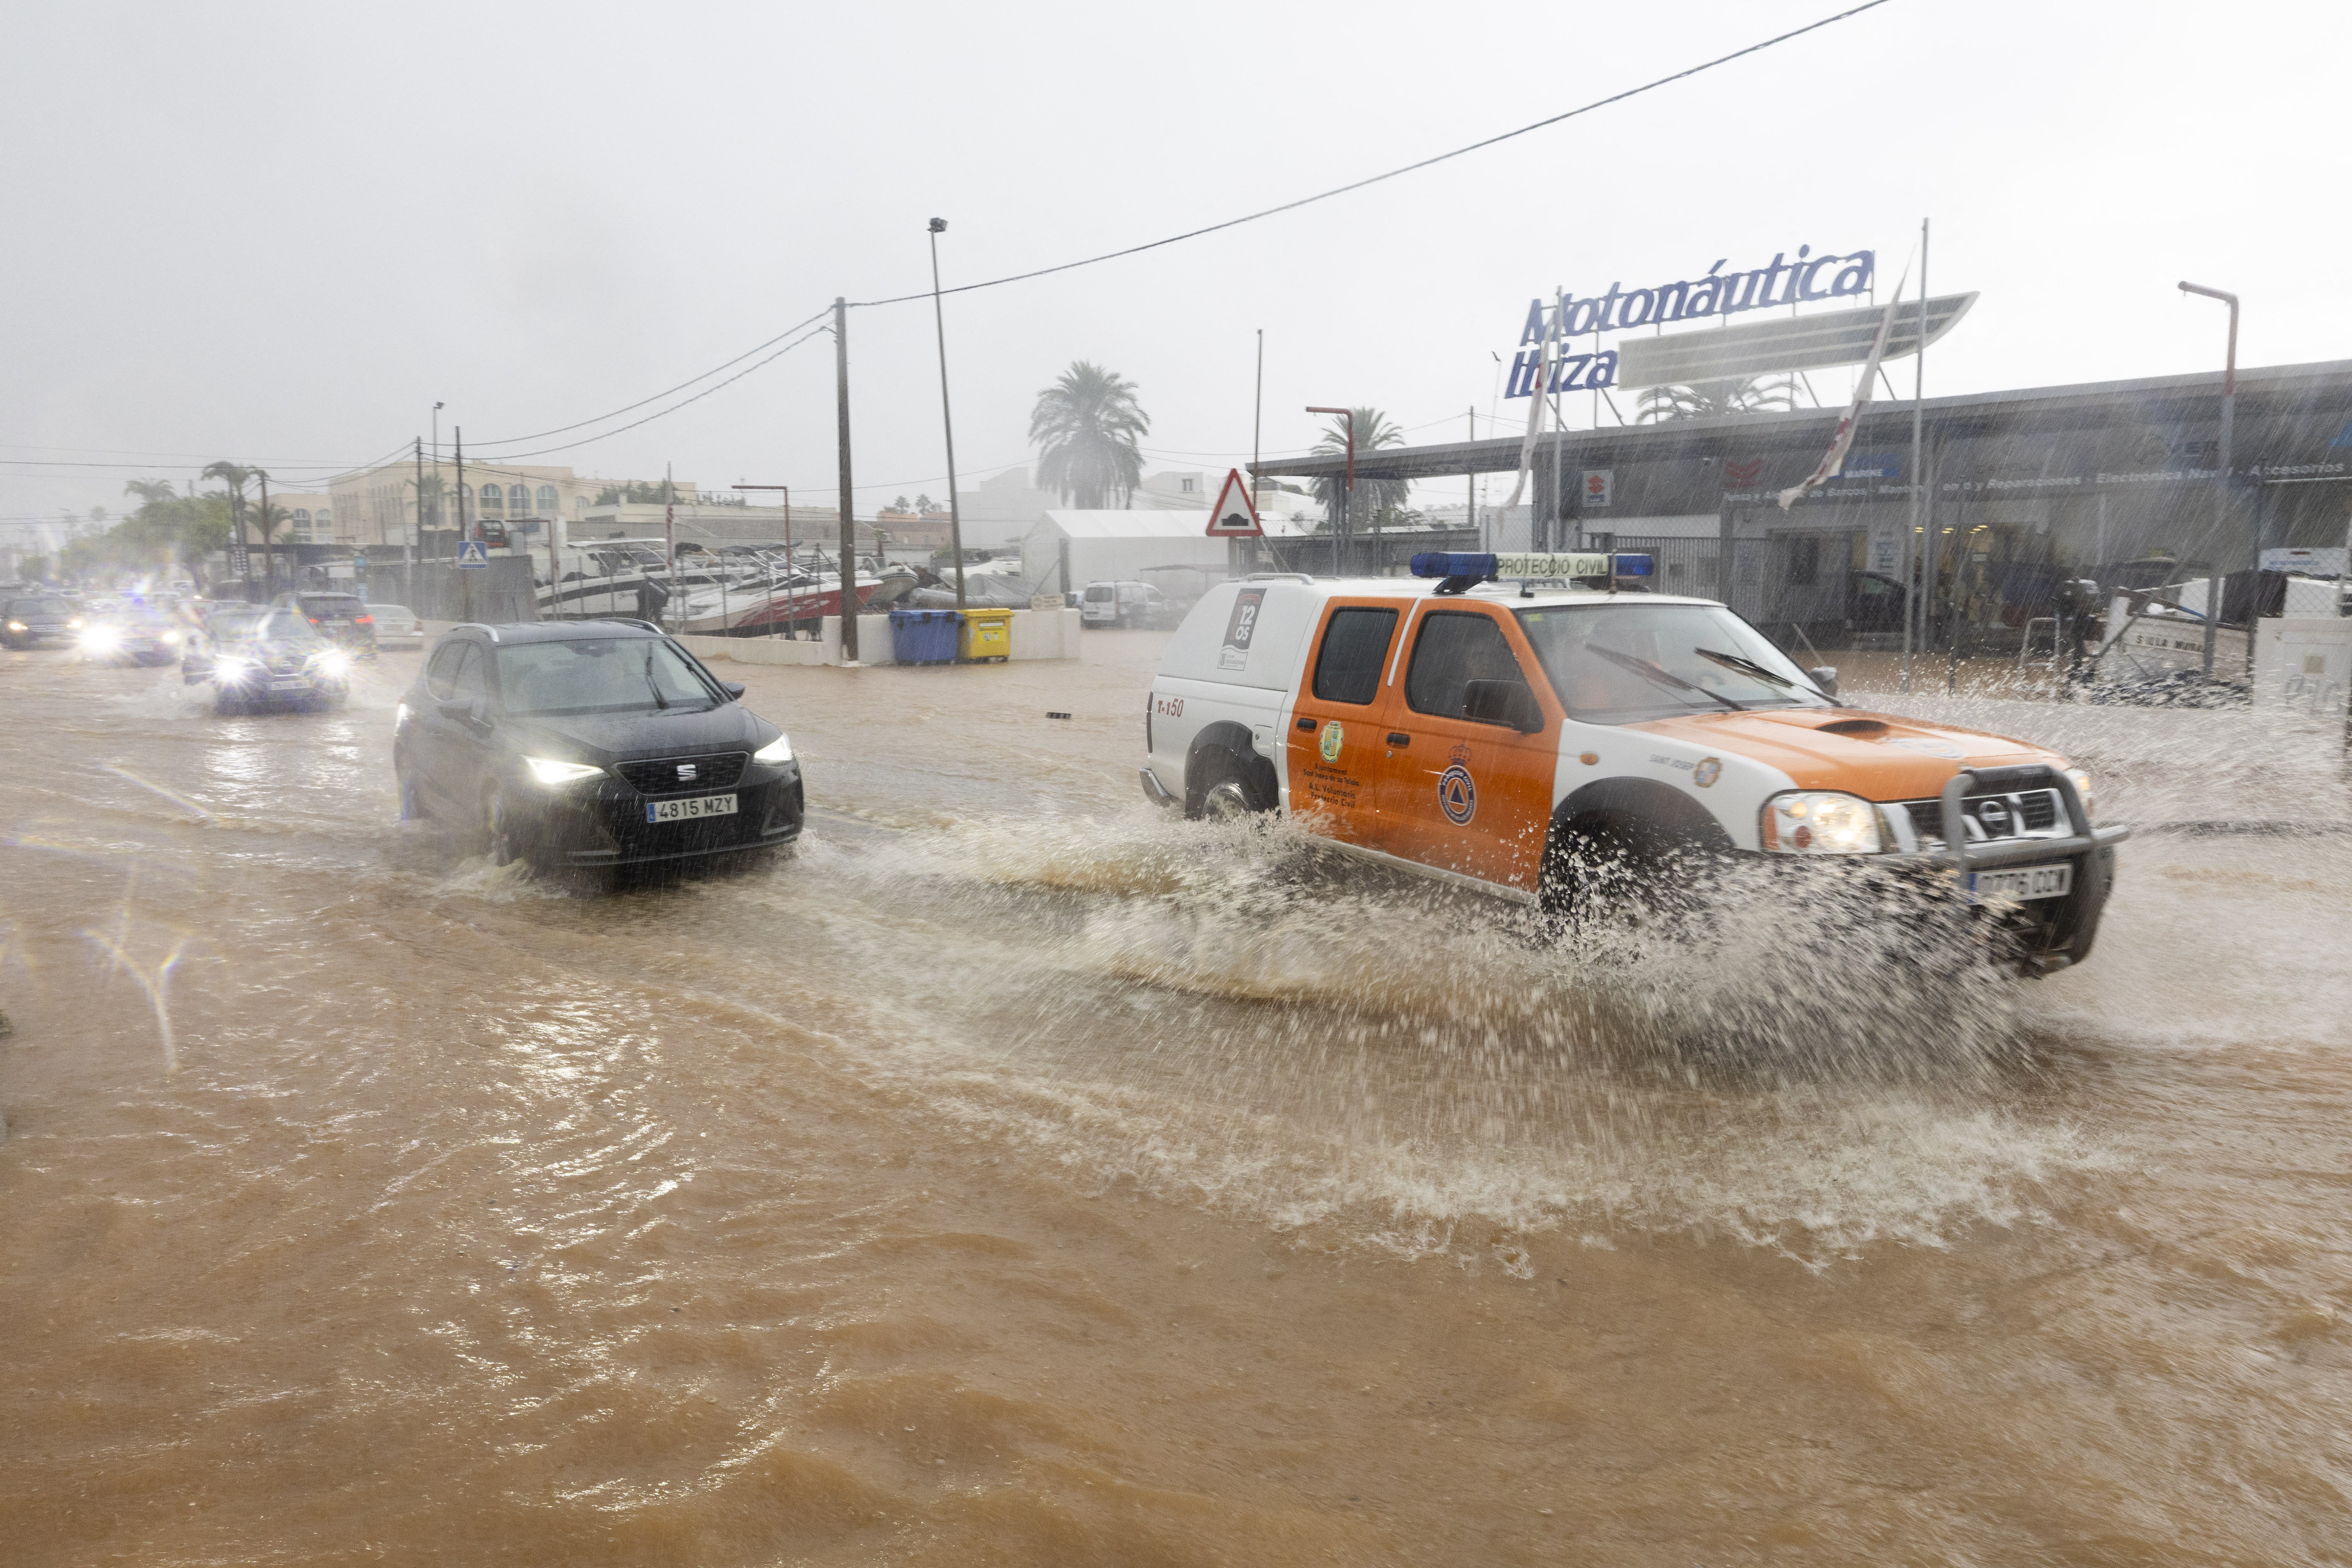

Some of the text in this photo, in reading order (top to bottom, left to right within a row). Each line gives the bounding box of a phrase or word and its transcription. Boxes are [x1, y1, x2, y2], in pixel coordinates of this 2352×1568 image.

[1520, 244, 1875, 347] Motonáutica
[1504, 342, 1619, 399] Ibiza
[1576, 558, 1608, 574] CIVIL
[1158, 698, 1184, 717] T-150
[1314, 763, 1347, 775] Ajuntament
[658, 796, 733, 818] 4815 MZY
